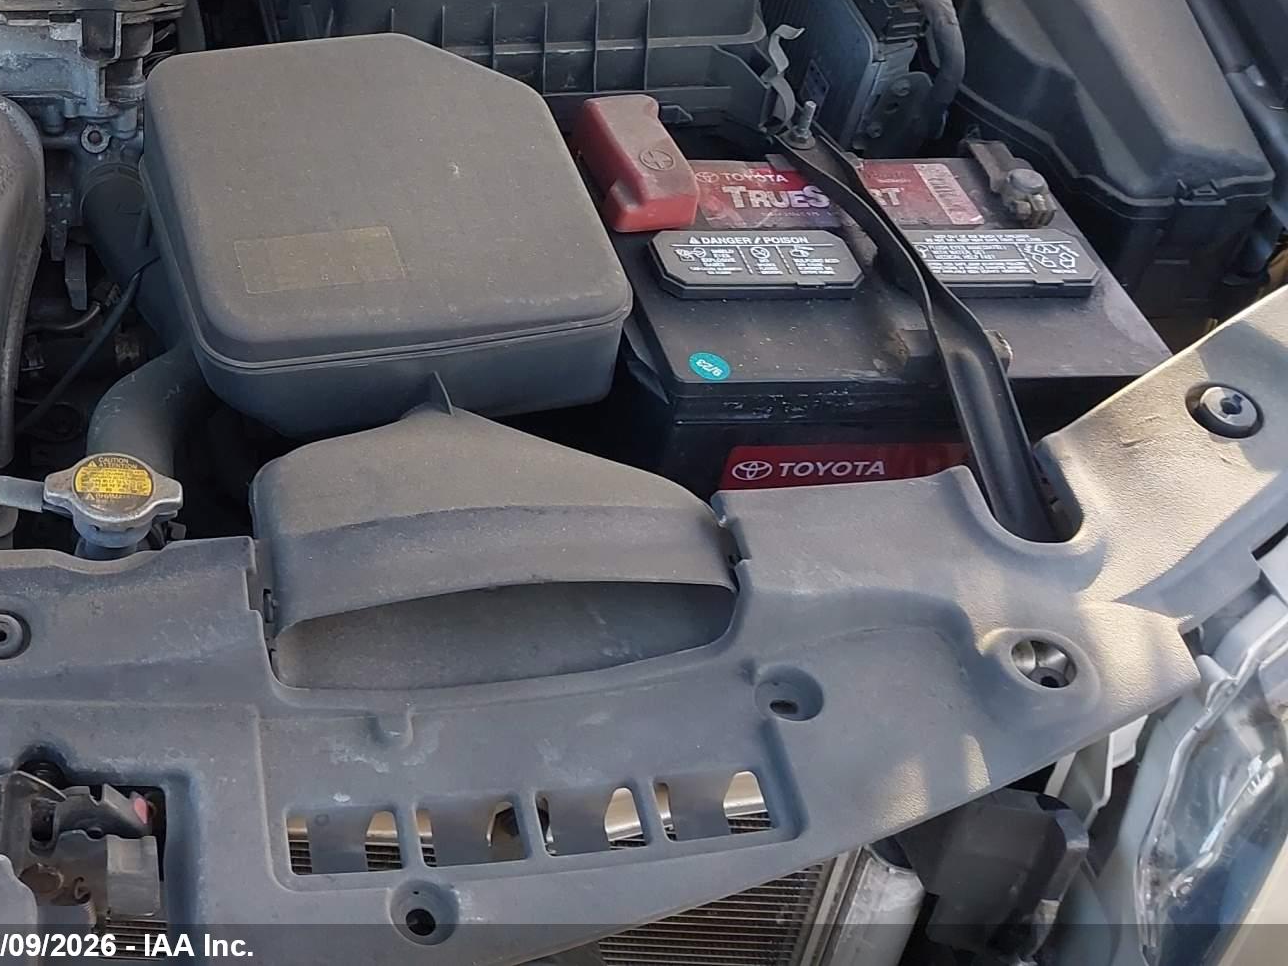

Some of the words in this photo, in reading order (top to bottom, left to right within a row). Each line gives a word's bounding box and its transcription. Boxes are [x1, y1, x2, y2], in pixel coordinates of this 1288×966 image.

[720, 171, 789, 183] TOYOTA
[700, 237, 752, 245] DANGER
[762, 236, 810, 245] POISON
[778, 460, 886, 477] TOYOTA
